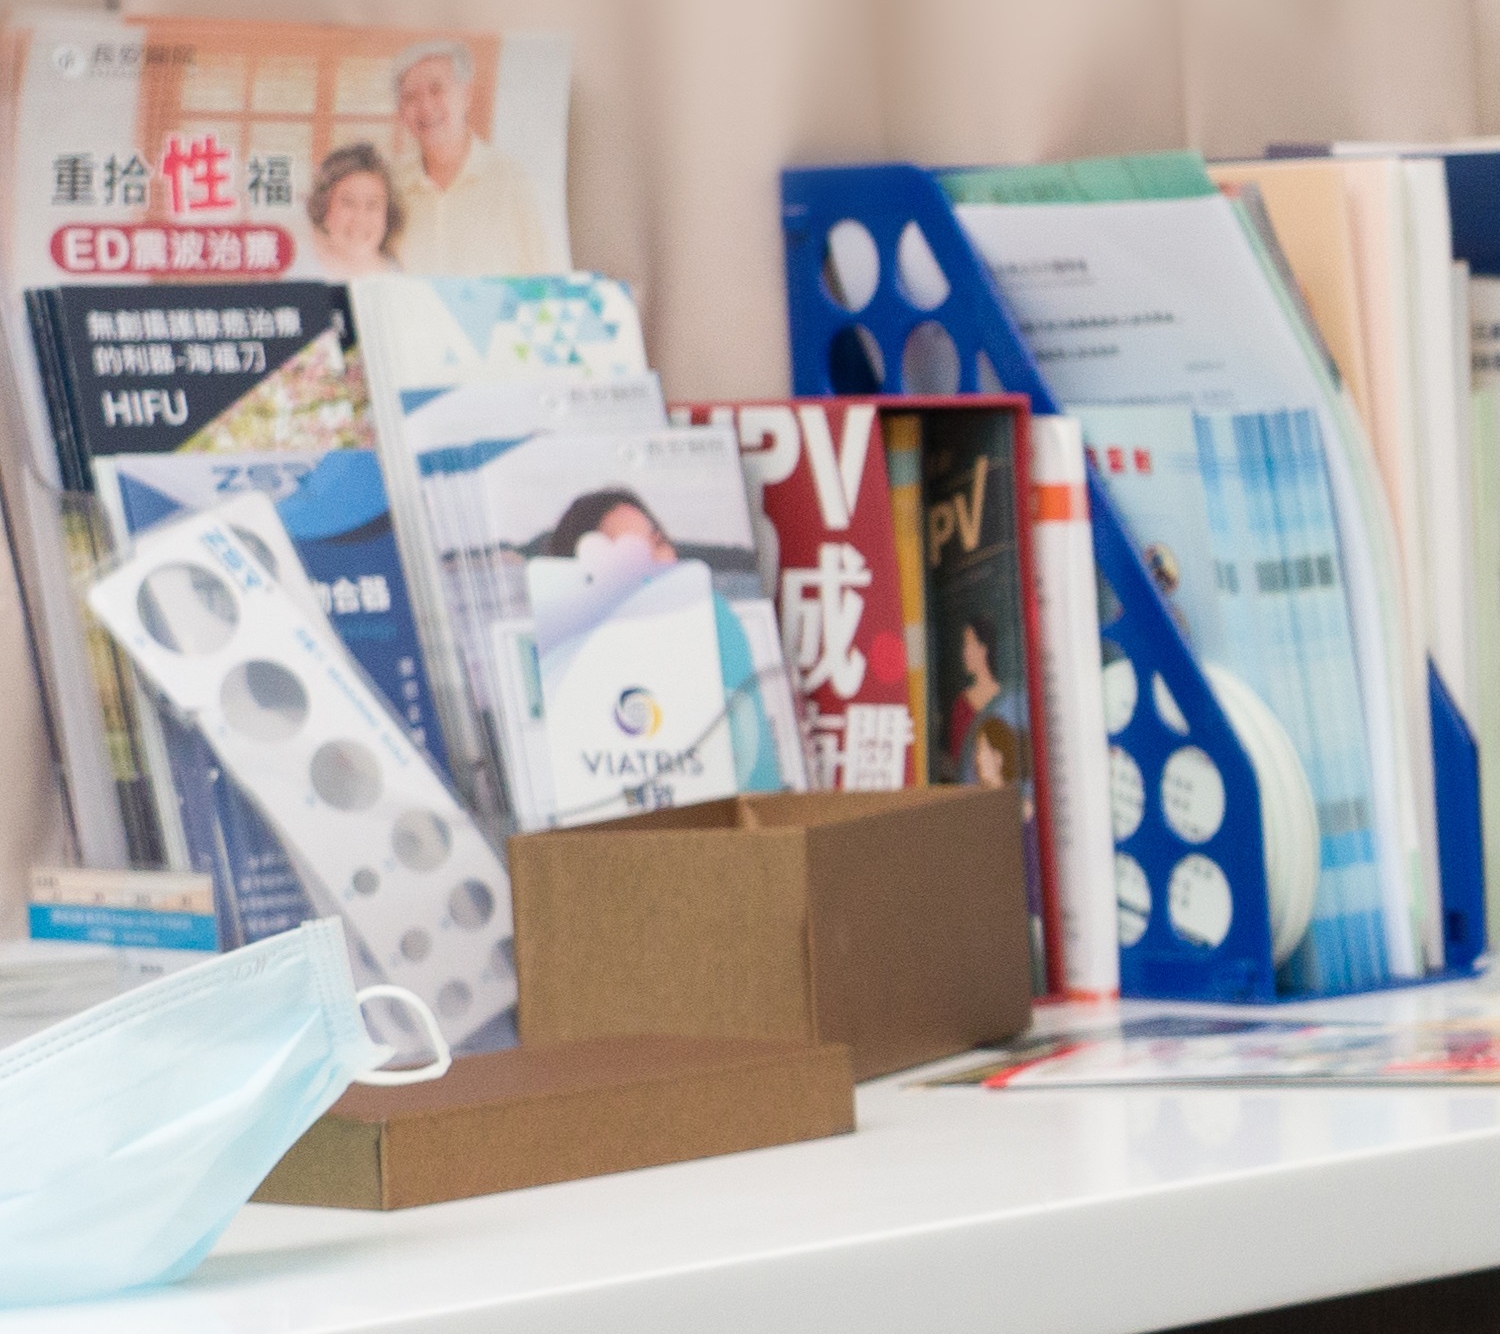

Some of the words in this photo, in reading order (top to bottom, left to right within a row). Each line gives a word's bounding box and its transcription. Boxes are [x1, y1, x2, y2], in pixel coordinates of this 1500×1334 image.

[52, 133, 293, 214] 重拾性福
[102, 388, 190, 428] HIFU
[670, 405, 880, 530] PV
